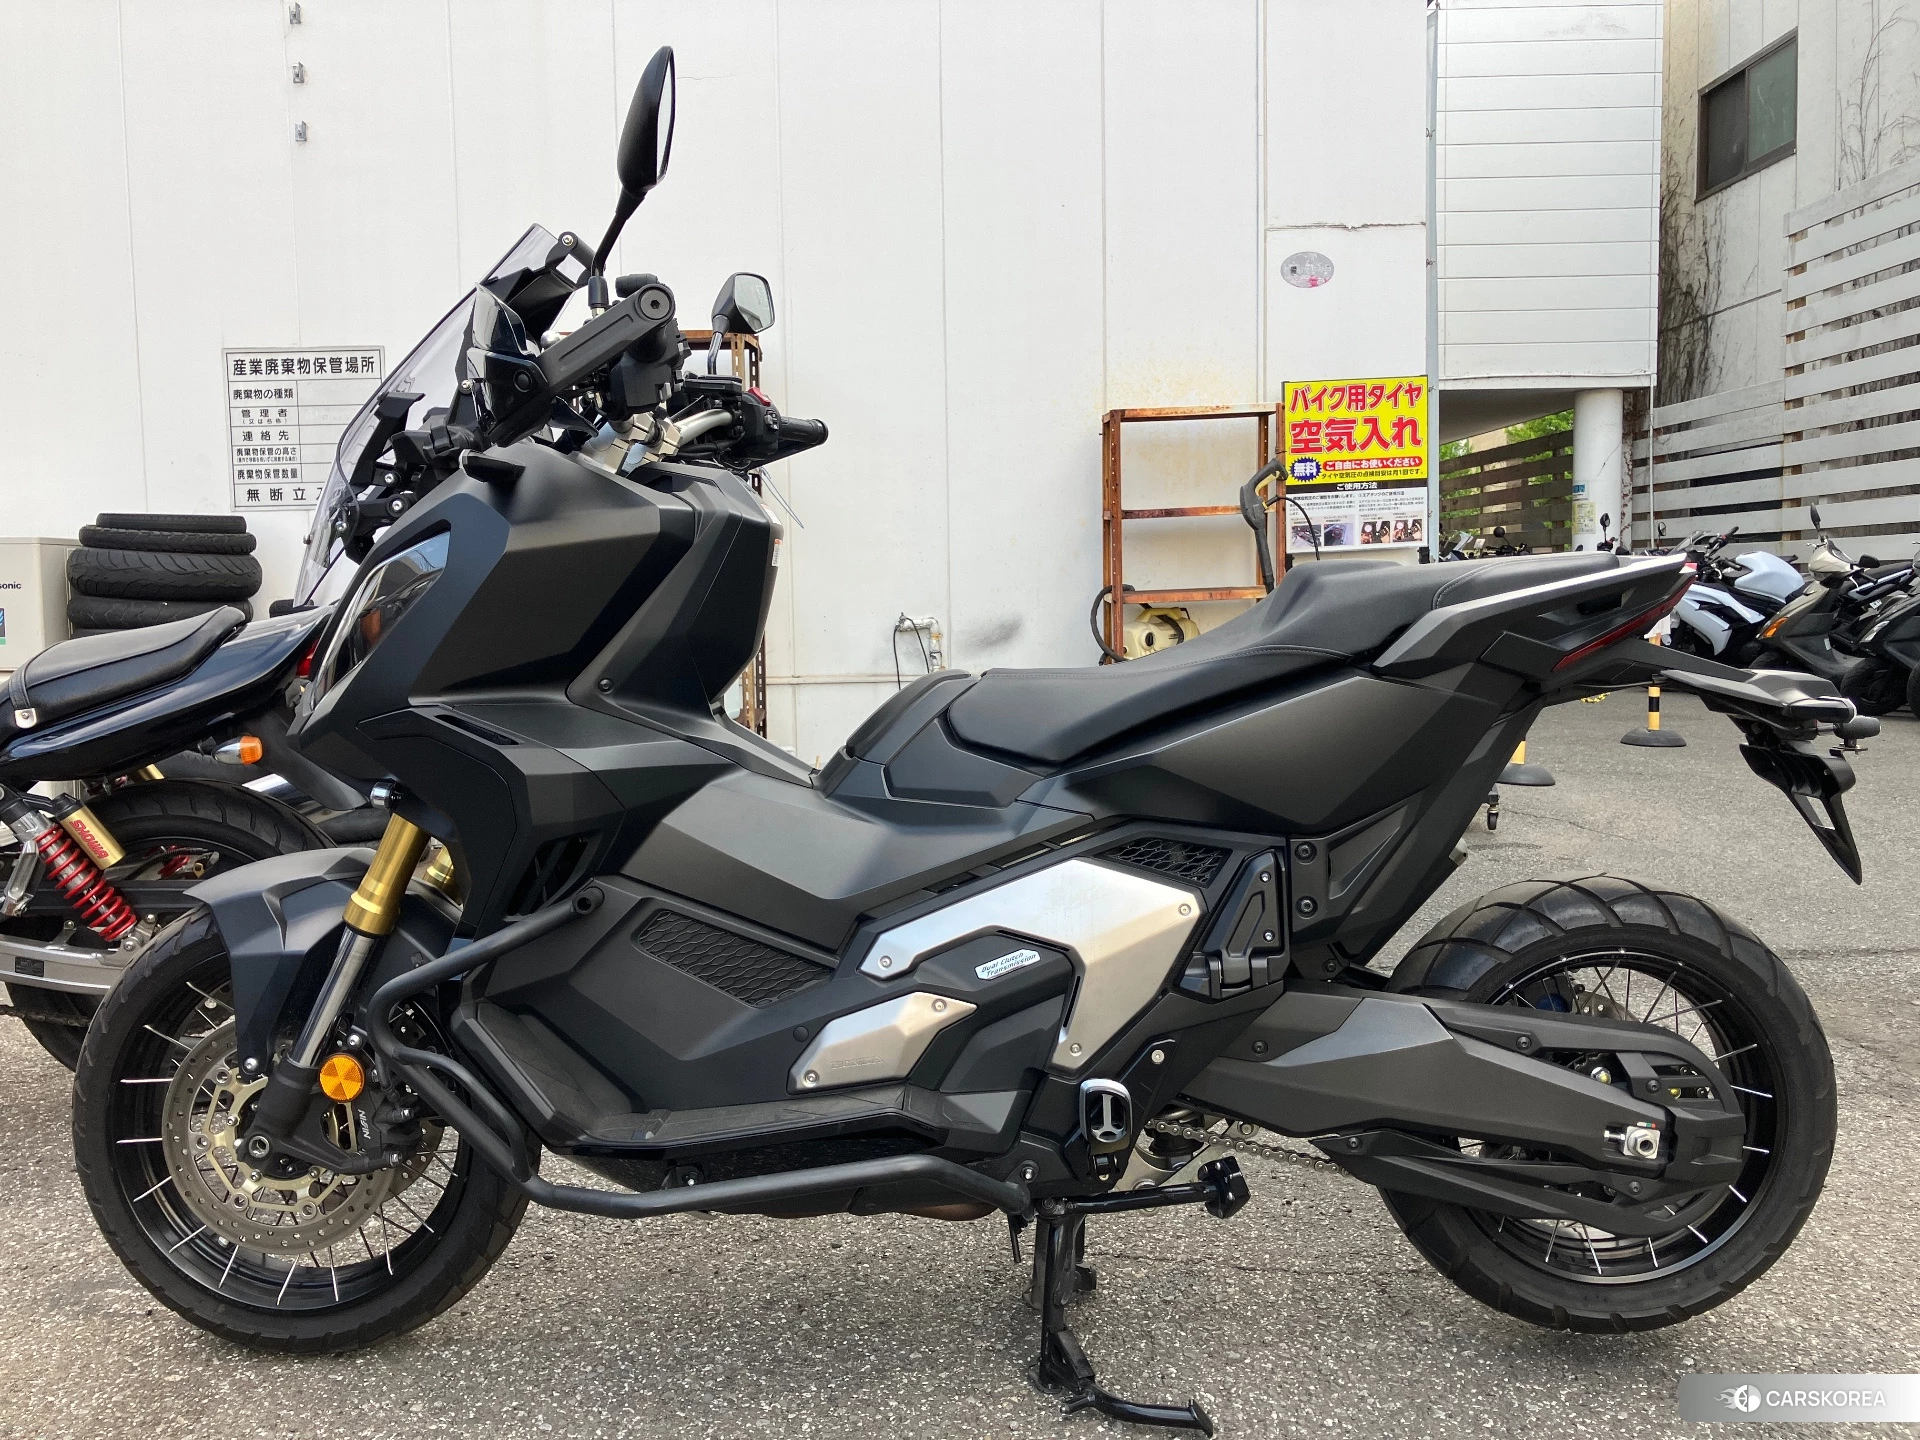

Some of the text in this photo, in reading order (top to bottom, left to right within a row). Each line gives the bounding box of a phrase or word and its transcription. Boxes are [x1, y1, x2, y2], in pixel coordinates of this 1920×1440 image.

[233, 356, 374, 376] 産業廃棄物保管場所
[233, 388, 294, 400] 廃棄物の種類
[1290, 382, 1423, 412] バイク用タイヤ
[242, 430, 289, 441] 連絡先
[1290, 416, 1423, 455] 空気入れ
[1293, 462, 1318, 477] 無料
[1325, 458, 1420, 470] ご自由にお使いください
[69, 820, 109, 858] SHOWA
[981, 952, 1024, 973] Dual Clutch
[986, 953, 1037, 978] Transmission
